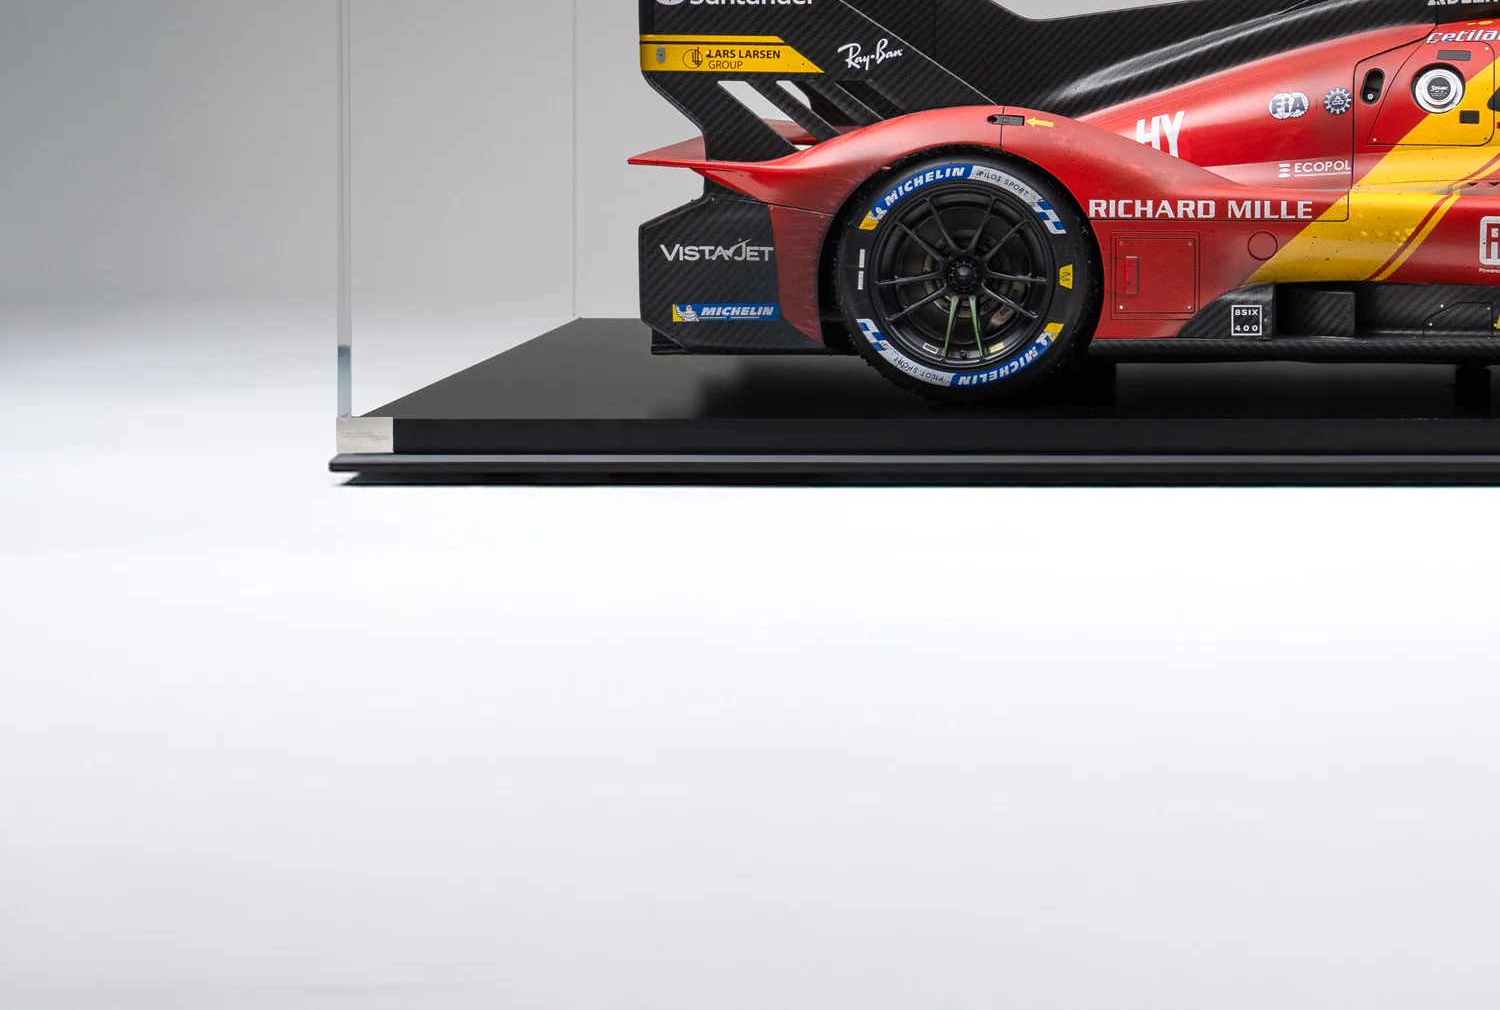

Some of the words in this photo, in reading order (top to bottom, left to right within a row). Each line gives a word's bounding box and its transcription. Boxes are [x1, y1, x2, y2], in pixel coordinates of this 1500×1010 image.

[708, 50, 736, 59] LARS
[738, 50, 781, 59] LARSEN
[708, 60, 743, 70] GROUP
[1294, 159, 1352, 173] ECOPOL
[885, 167, 965, 206] MICHELIN
[1004, 177, 1029, 197] SPORT
[1088, 199, 1216, 219] RICHARD
[1227, 200, 1313, 219] MILLE
[701, 306, 774, 316] MICHELIN
[957, 346, 1039, 386] MICHELIN
